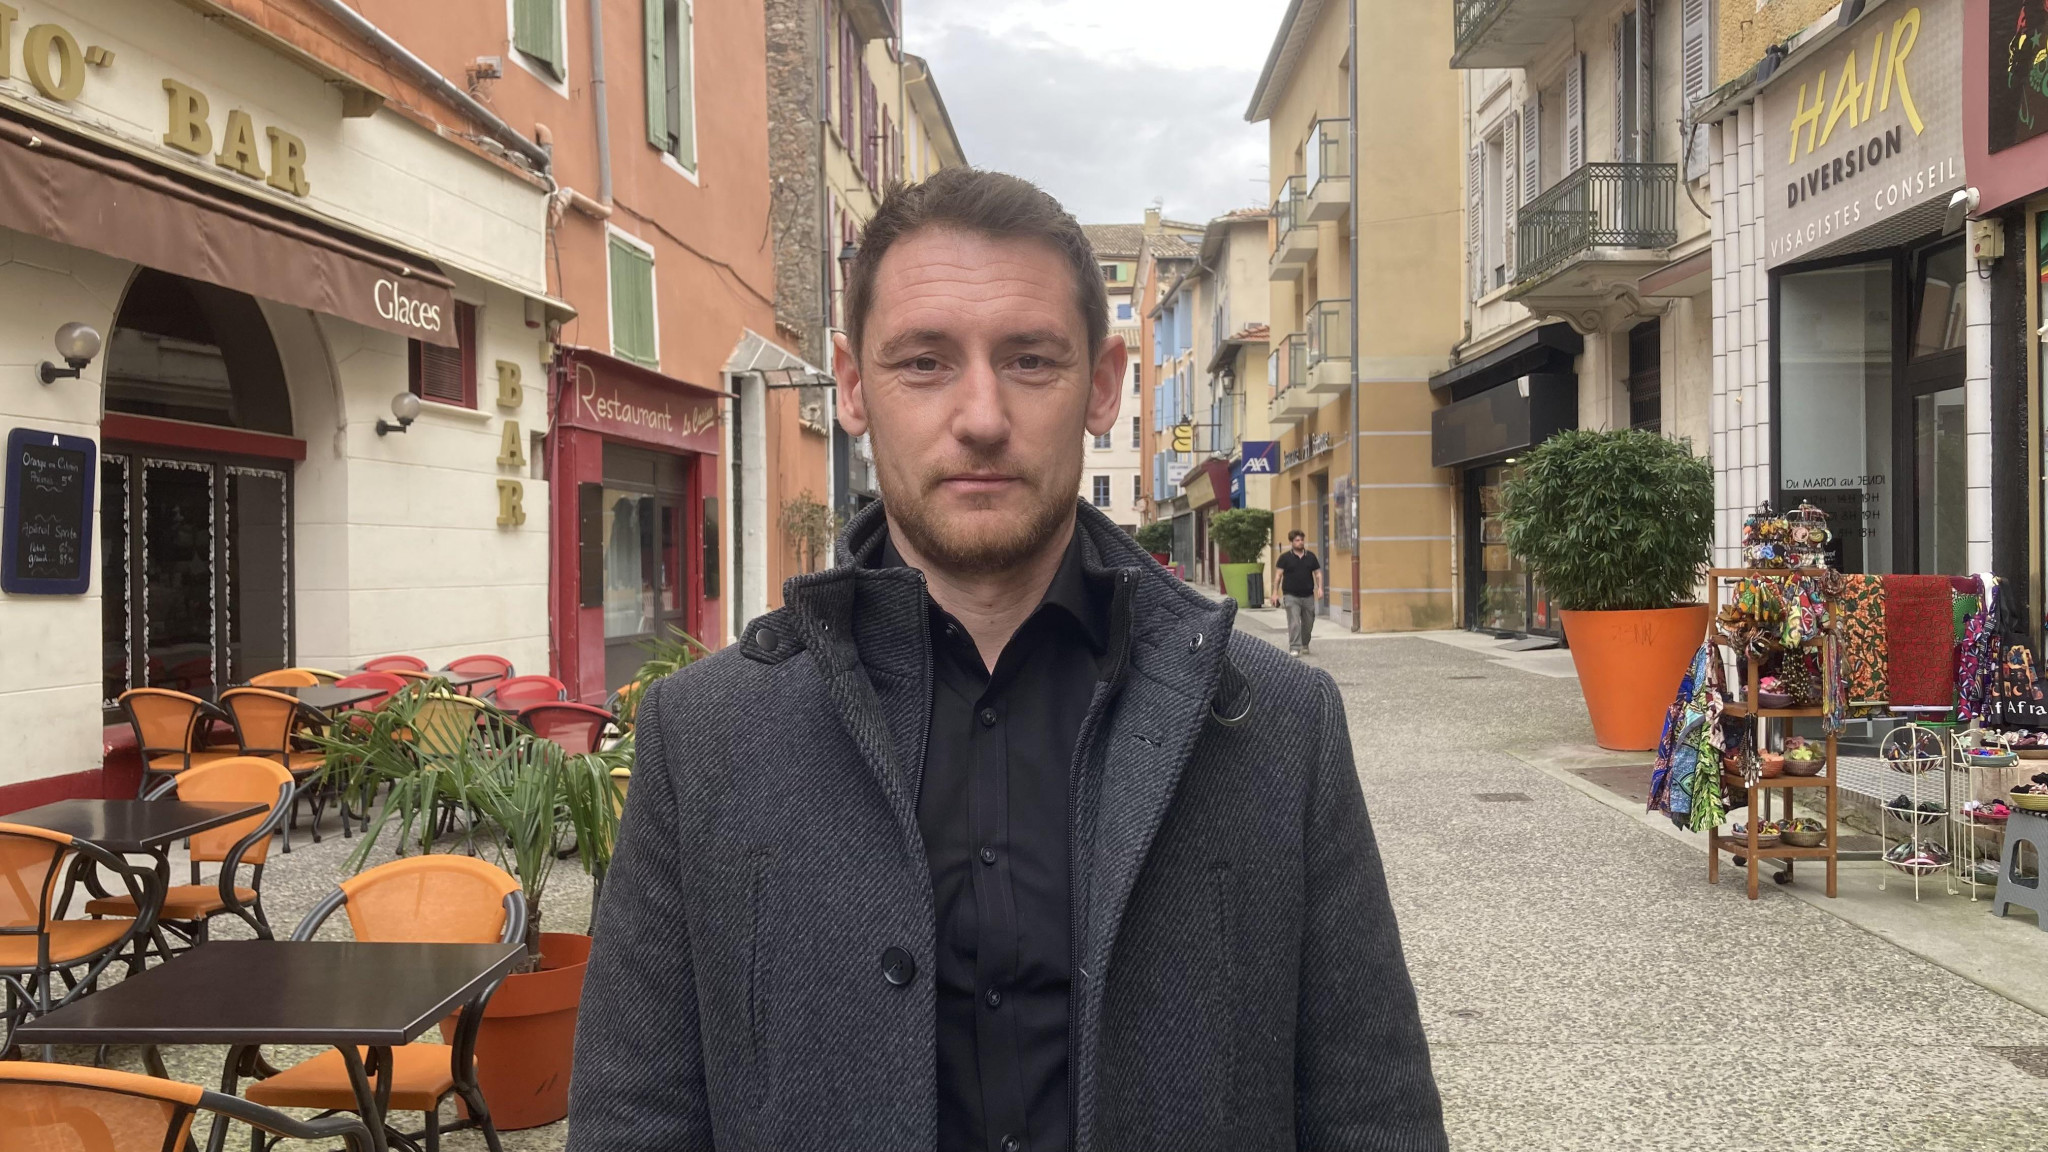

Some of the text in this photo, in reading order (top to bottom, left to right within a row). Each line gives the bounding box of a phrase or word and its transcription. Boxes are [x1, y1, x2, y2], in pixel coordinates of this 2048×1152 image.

[1789, 7, 1924, 165] HAIR
[162, 78, 310, 197] BAR
[1787, 125, 1900, 208] DIVERSION
[1770, 157, 1956, 258] VISAGISTES CONSEIL
[374, 279, 441, 332] Glaces
[576, 363, 673, 433] Restaurant
[22, 452, 46, 473] Orange
[495, 359, 526, 526] BAR
[1242, 457, 1270, 472] AXA
[1786, 475, 1885, 489] Du MARDI au JEUDI
